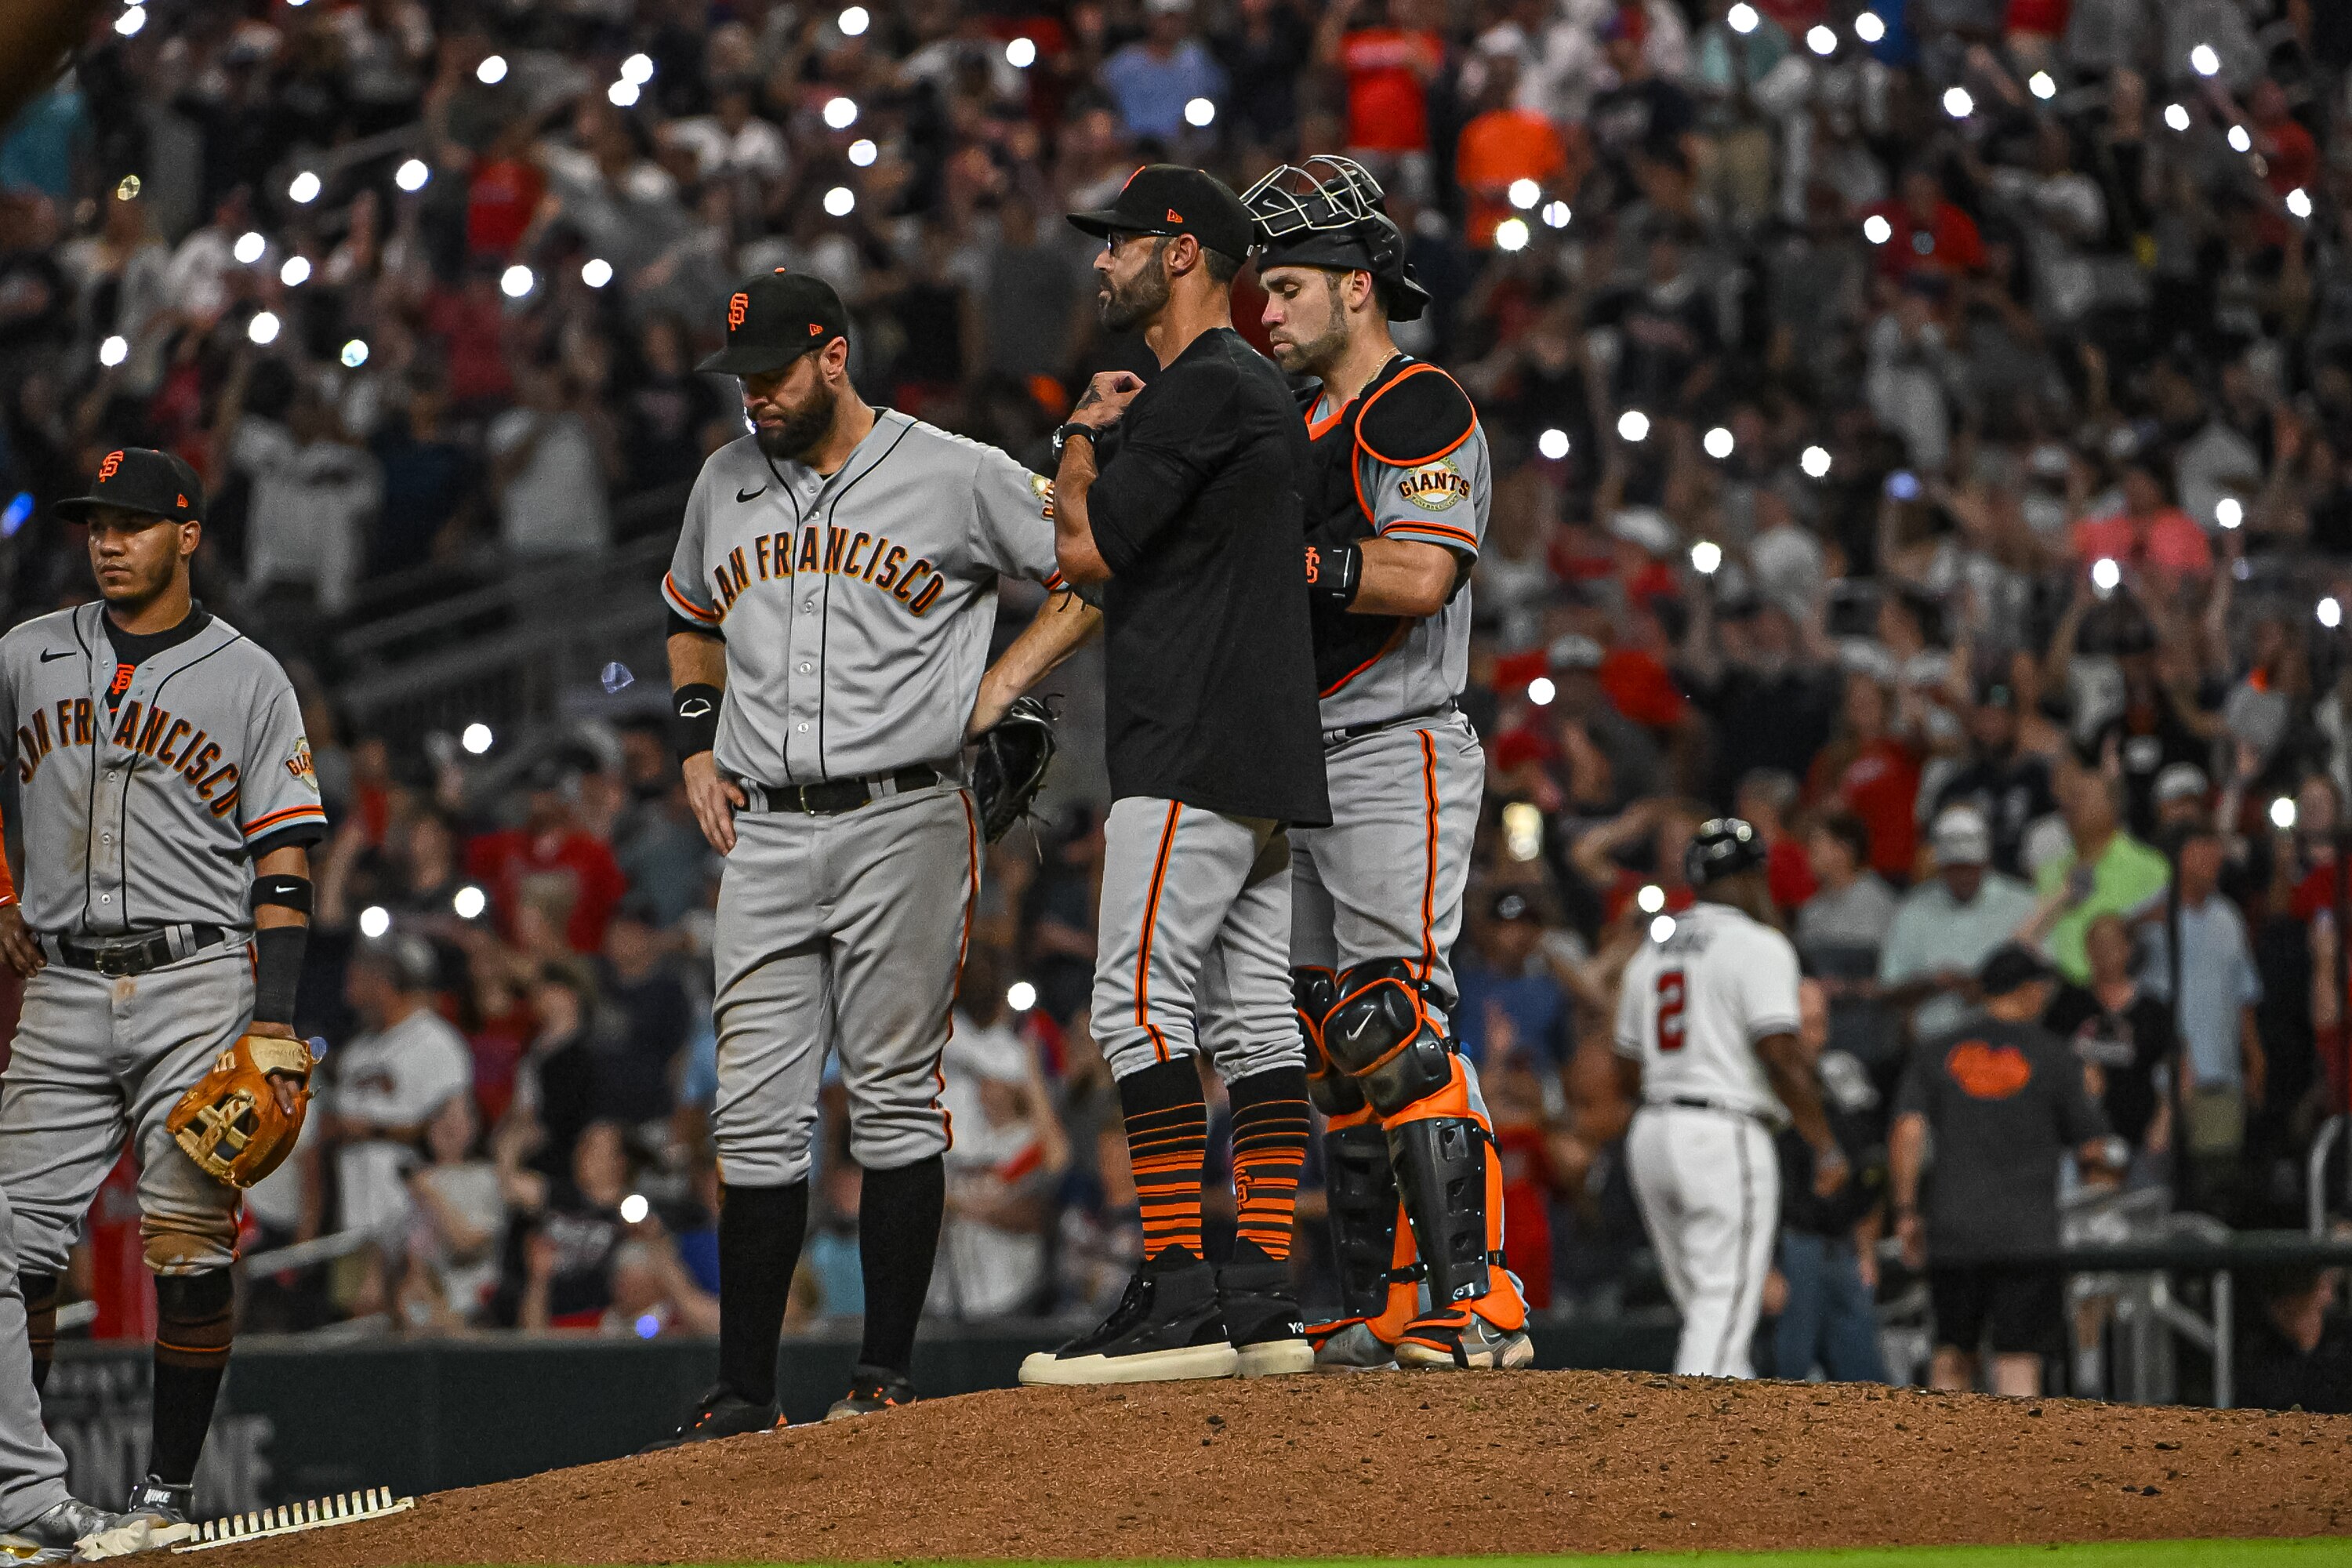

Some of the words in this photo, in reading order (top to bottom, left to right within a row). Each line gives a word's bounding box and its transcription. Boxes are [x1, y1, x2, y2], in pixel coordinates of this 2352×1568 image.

[728, 292, 749, 332] SF
[99, 450, 124, 483] SF
[1398, 472, 1470, 499] GIANTS
[755, 526, 944, 616] FRANCISCO
[56, 697, 241, 818] FRANCISCO
[1656, 971, 1687, 1051] 2
[1287, 1322, 1305, 1334] Y-3
